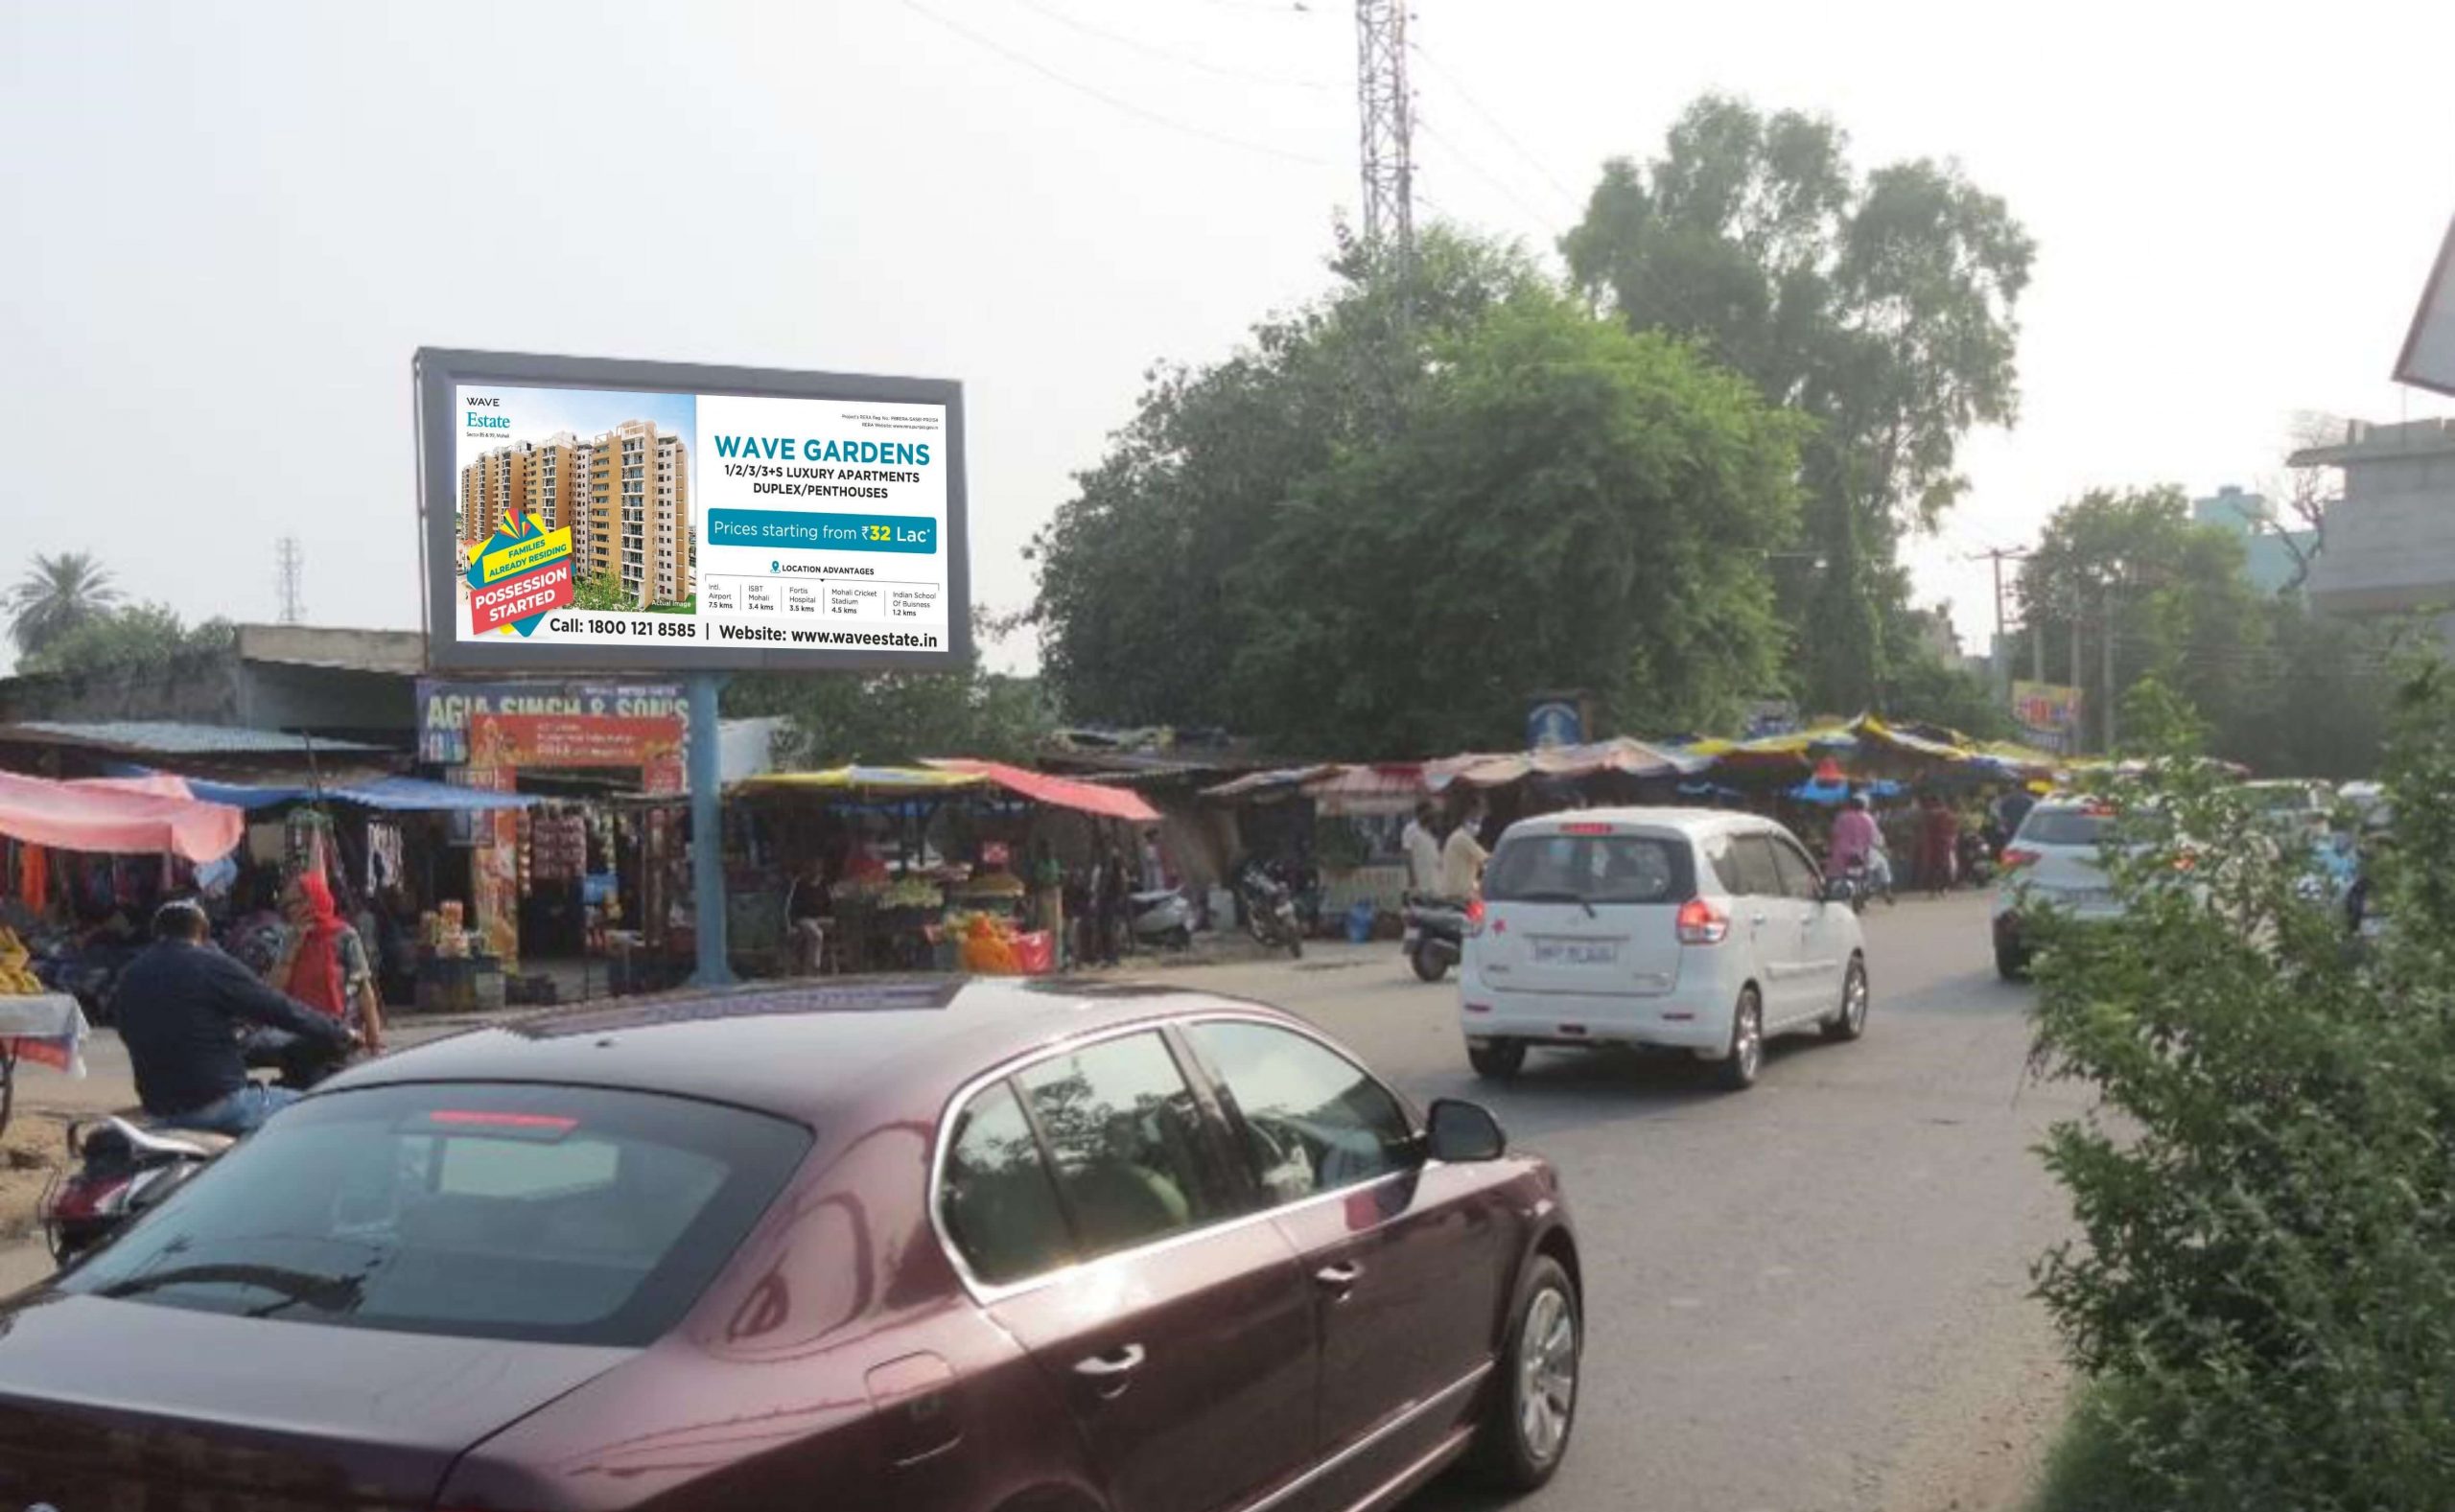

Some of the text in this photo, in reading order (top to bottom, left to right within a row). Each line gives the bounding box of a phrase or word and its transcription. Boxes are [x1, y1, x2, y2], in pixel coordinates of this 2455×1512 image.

[467, 397, 500, 407] WAVE
[466, 411, 511, 429] Estate
[714, 435, 930, 465] WAVE GARDENS
[725, 464, 920, 483] 1/2/3/3+S LUXURY APARTMENTS
[753, 483, 888, 499] DUPLEX/PENTHOUSES
[714, 521, 757, 536] Prices
[762, 523, 818, 541] starting
[823, 524, 857, 539] from
[508, 539, 546, 559] FAMILIES
[489, 544, 567, 577] ALREADY RESIDING
[782, 565, 875, 575] LOCATION ADVANTAGES
[475, 567, 568, 609] POSSESSION
[709, 592, 732, 601] Airport
[789, 586, 808, 594] Fortis
[831, 589, 877, 598] Mohali Cricket
[892, 591, 912, 599] Indian
[489, 589, 556, 622] STARTED
[748, 593, 770, 602] Mohali
[789, 595, 816, 605] Hospital
[831, 597, 858, 606] Stadium
[550, 618, 696, 638] Call: 1800 121 8585
[719, 625, 937, 648] Website: www.waveestate.in
